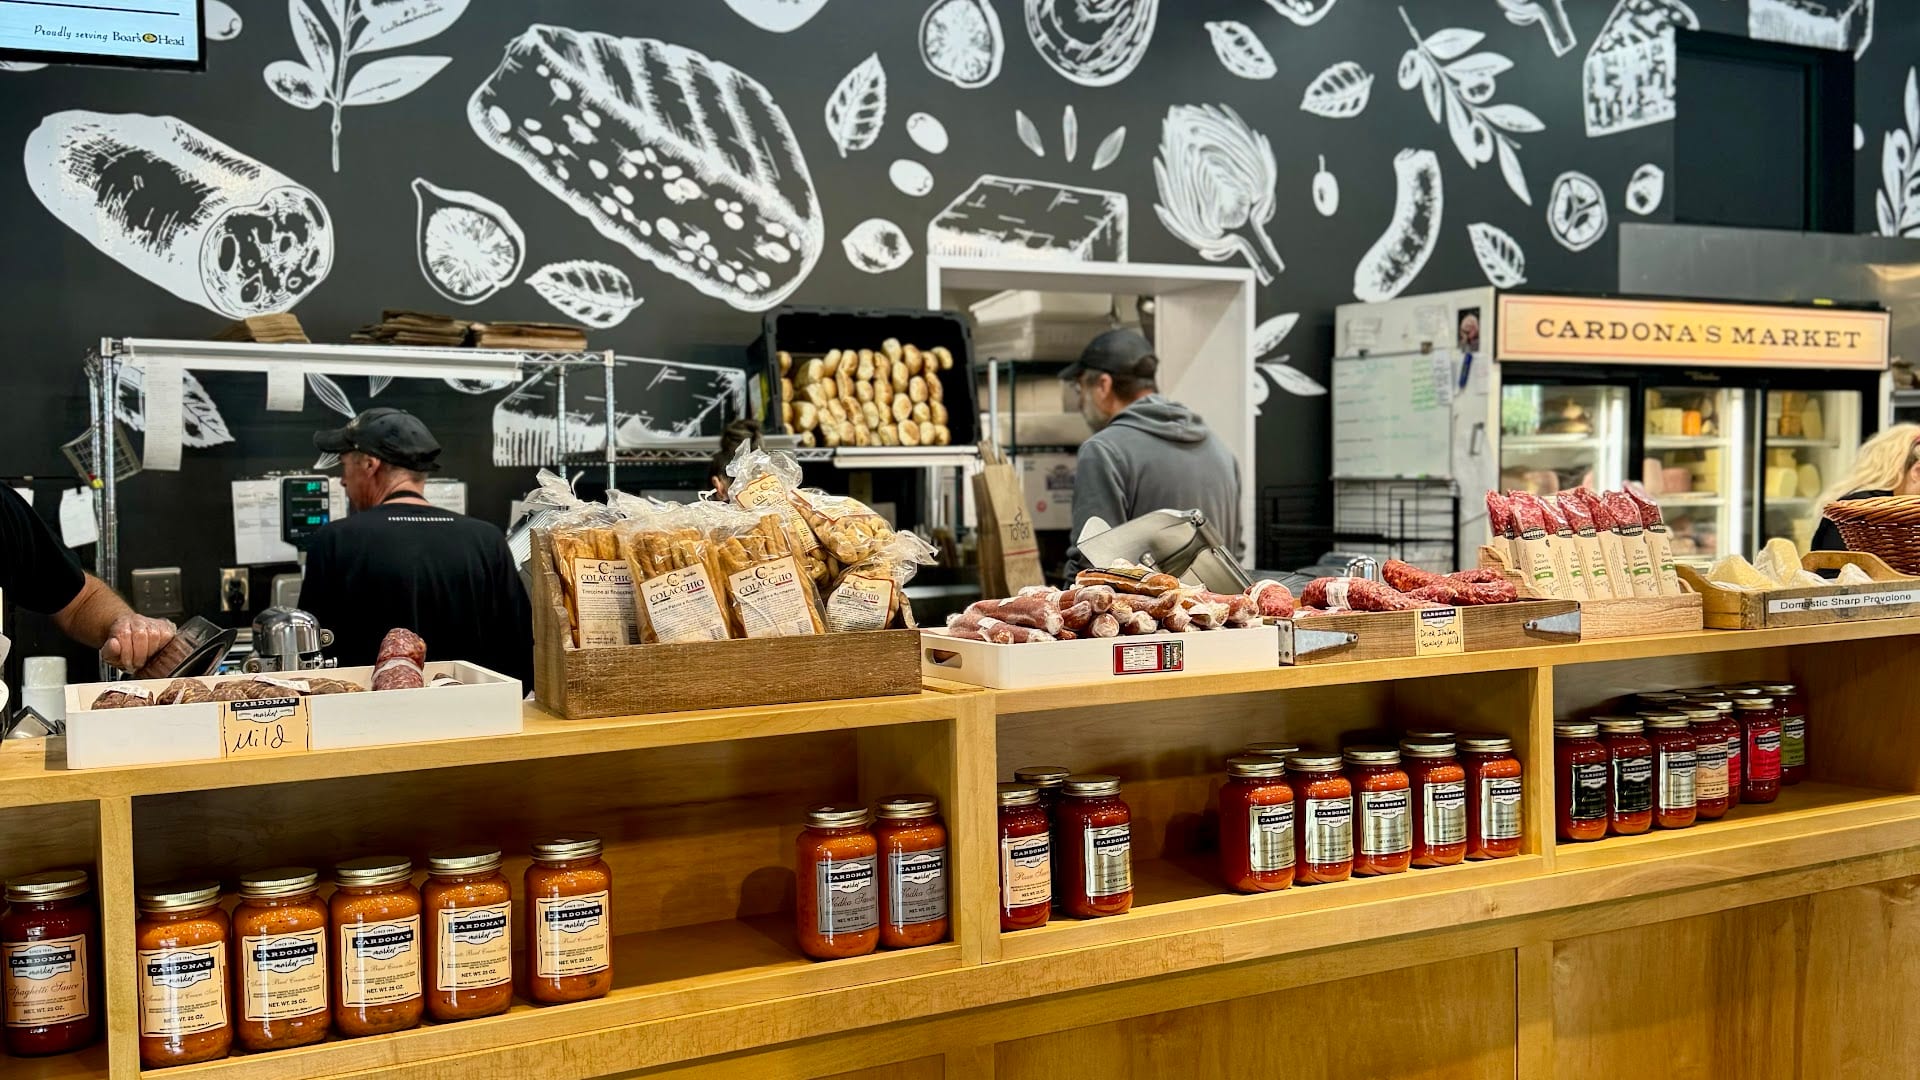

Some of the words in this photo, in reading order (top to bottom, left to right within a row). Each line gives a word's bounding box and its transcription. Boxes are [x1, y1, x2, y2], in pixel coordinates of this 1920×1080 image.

[34, 24, 72, 39] Proudly
[75, 32, 108, 42] serving
[113, 31, 142, 42] Boar's
[158, 34, 184, 46] Head
[1536, 318, 1722, 343] CARDONA'S
[1732, 327, 1861, 348] MARKET
[581, 574, 632, 582] COLACCHIO
[740, 572, 792, 594] COLACCHIO
[650, 579, 704, 602] COLACCHIO
[1780, 600, 1828, 610] Domestic
[1831, 596, 1860, 606] Sharp
[1864, 593, 1911, 604] Provolone
[234, 698, 296, 708] CARDONA'S
[253, 710, 278, 718] market
[232, 724, 292, 752] Mild
[548, 908, 600, 919] CARDONA'S
[453, 919, 505, 929] CARDONA'S
[356, 934, 412, 945] CARDONA'S
[256, 946, 315, 958] CARDONA'S
[12, 953, 72, 964] CARDONA'S
[150, 960, 212, 973] CARDONA'S
[8, 984, 48, 999] Spaghetti
[51, 980, 79, 992] Sauce
